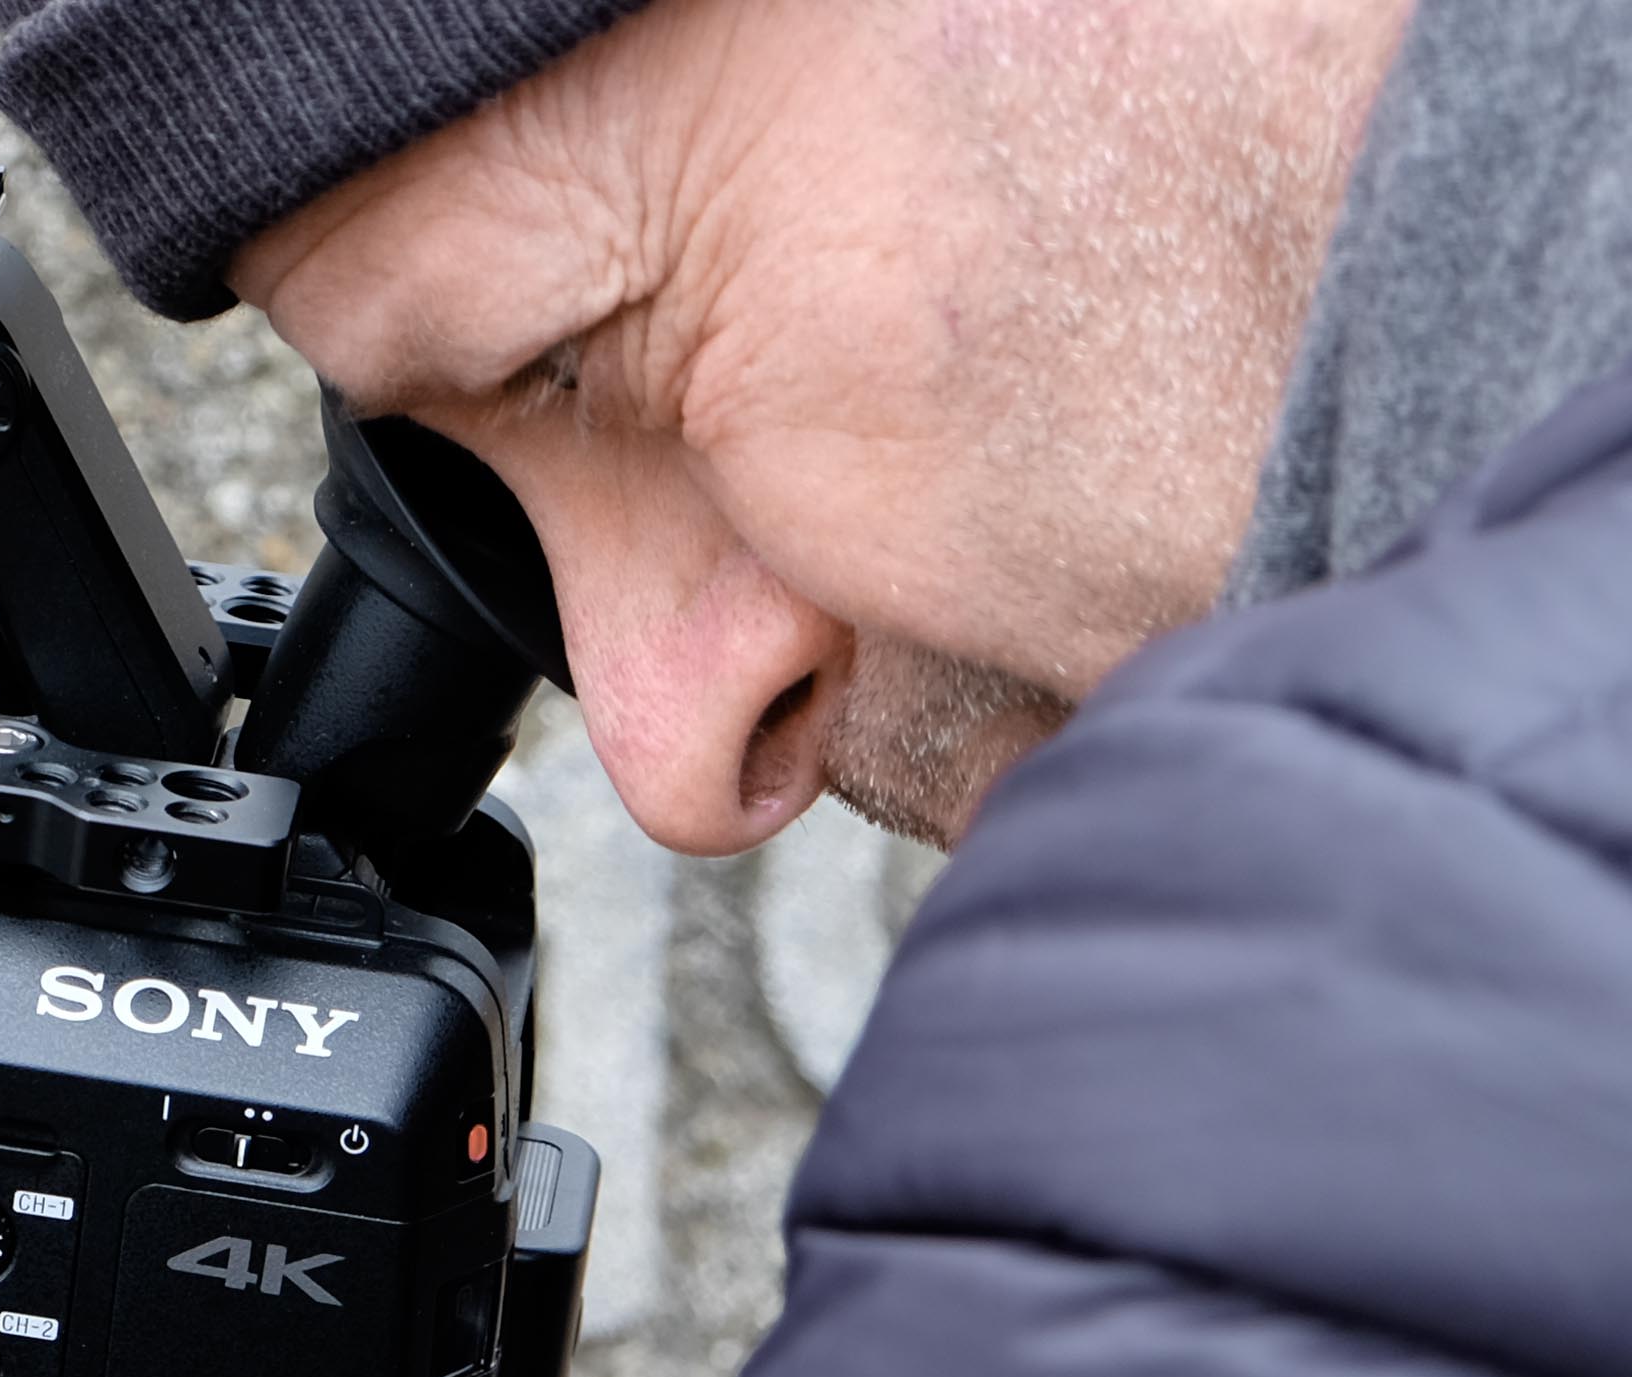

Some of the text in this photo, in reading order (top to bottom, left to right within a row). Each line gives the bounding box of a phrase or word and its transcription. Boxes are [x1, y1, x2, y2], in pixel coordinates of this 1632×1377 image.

[35, 966, 360, 1058] SONY
[17, 1192, 68, 1218] CH-1
[166, 1235, 345, 1307] 4K
[1, 1314, 54, 1338] CH-2
